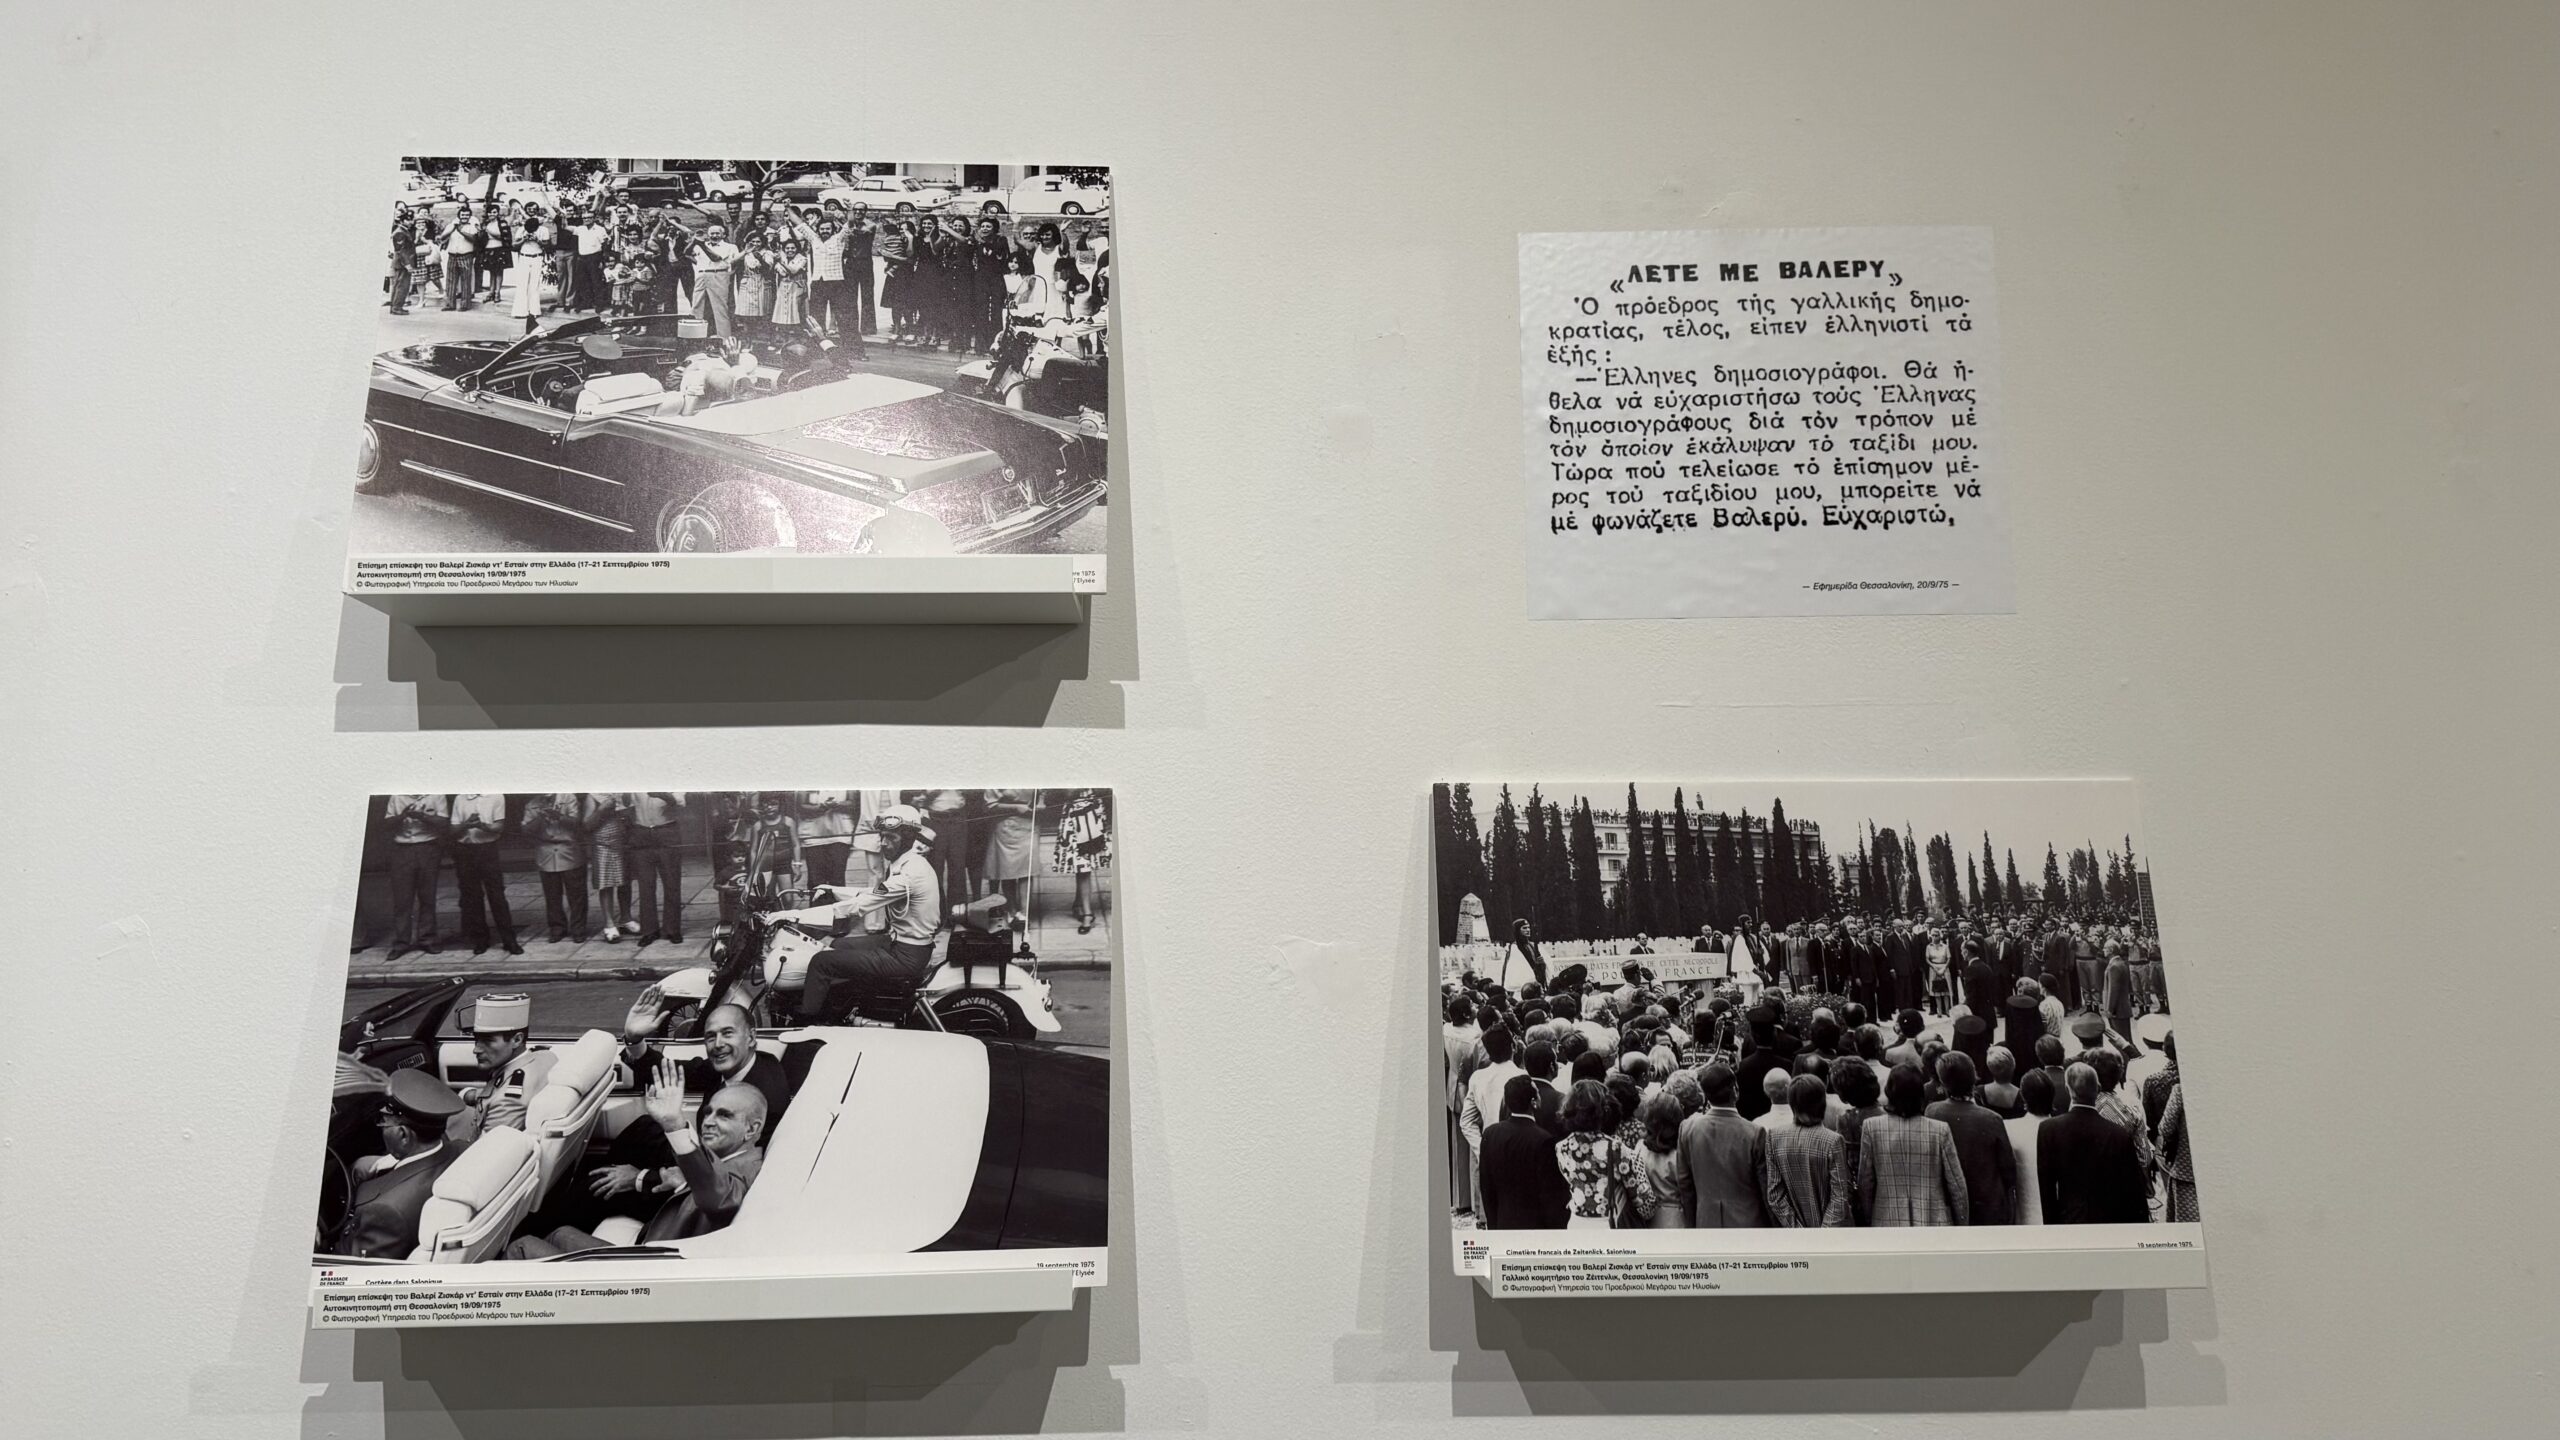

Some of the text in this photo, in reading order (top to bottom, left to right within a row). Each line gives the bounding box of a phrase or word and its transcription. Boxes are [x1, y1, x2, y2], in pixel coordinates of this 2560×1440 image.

[1720, 263, 1759, 283] ΜΕ
[1910, 290, 1970, 313] δημο-
[1549, 391, 1602, 411] θελα
[1932, 437, 1978, 455] μου.
[1552, 492, 1590, 509] ρος
[1776, 485, 1822, 505] μου,
[358, 562, 388, 570] Επίσημη
[389, 562, 424, 570] επίσκεψη
[439, 562, 465, 570] Βαλερί
[466, 561, 491, 569] Ζισκάρ
[602, 561, 650, 569] Σεπτεμβρίου
[356, 571, 422, 580] Αυτοκινητοπομπή
[438, 570, 486, 579] Θεσσαλονίκη
[487, 570, 527, 578] 19/09/1975
[365, 581, 411, 590] Φωτογραφική
[412, 580, 446, 589] Υπηρεσία
[460, 580, 501, 588] Προεδρικού
[502, 580, 534, 588] Μεγάρου
[1813, 580, 1949, 592] Εφημερίδα Θεσσαλονίκη, 20/9/75
[1665, 967, 1712, 978] FRANCE
[1502, 1264, 1532, 1273] Επίσημη
[1533, 1264, 1567, 1272] επίσκεψη
[1582, 1264, 1607, 1272] Βαλερί
[1608, 1263, 1634, 1272] Ζισκάρ
[1646, 1262, 1671, 1270] Εσταίν
[1690, 1262, 1718, 1270] Ελλάδα
[1743, 1262, 1789, 1270] Σεπτεμβρίου
[1790, 1261, 1809, 1270] 1975)
[1502, 1274, 1530, 1282] Γαλλικό
[1531, 1274, 1570, 1283] κοιμητήριο
[1586, 1273, 1621, 1282] Ζέιτενλικ,
[1622, 1272, 1669, 1282] Θεσσαλονίκη
[1670, 1272, 1709, 1280] 19/09/1975
[1510, 1284, 1557, 1293] Φωτογραφική
[1558, 1284, 1590, 1293] Υπηρεσία
[1605, 1283, 1645, 1292] Προεδρικού
[1646, 1283, 1677, 1292] Μεγάρου
[1692, 1282, 1721, 1290] Ηλυσίων
[324, 1294, 356, 1303] Επίσημη
[357, 1292, 394, 1302] επίσκεψη
[410, 1292, 437, 1301] Βαλερί
[438, 1291, 465, 1300] Ζισκάρ
[478, 1290, 504, 1299] Εσταίν
[524, 1290, 553, 1298] Ελλάδα
[580, 1288, 629, 1297] Σεπτεμβρίου
[631, 1288, 651, 1296] 1975)
[323, 1301, 502, 1313] Αυτοκινητοπομπή στη Θεσσαλονίκη 19/09/1975
[331, 1314, 380, 1324] Φωτογραφική
[382, 1313, 417, 1323] Υπηρεσία
[432, 1312, 475, 1322] Προεδρικού
[476, 1312, 509, 1320] Μεγάρου
[525, 1310, 556, 1318] Ηλυσίων
